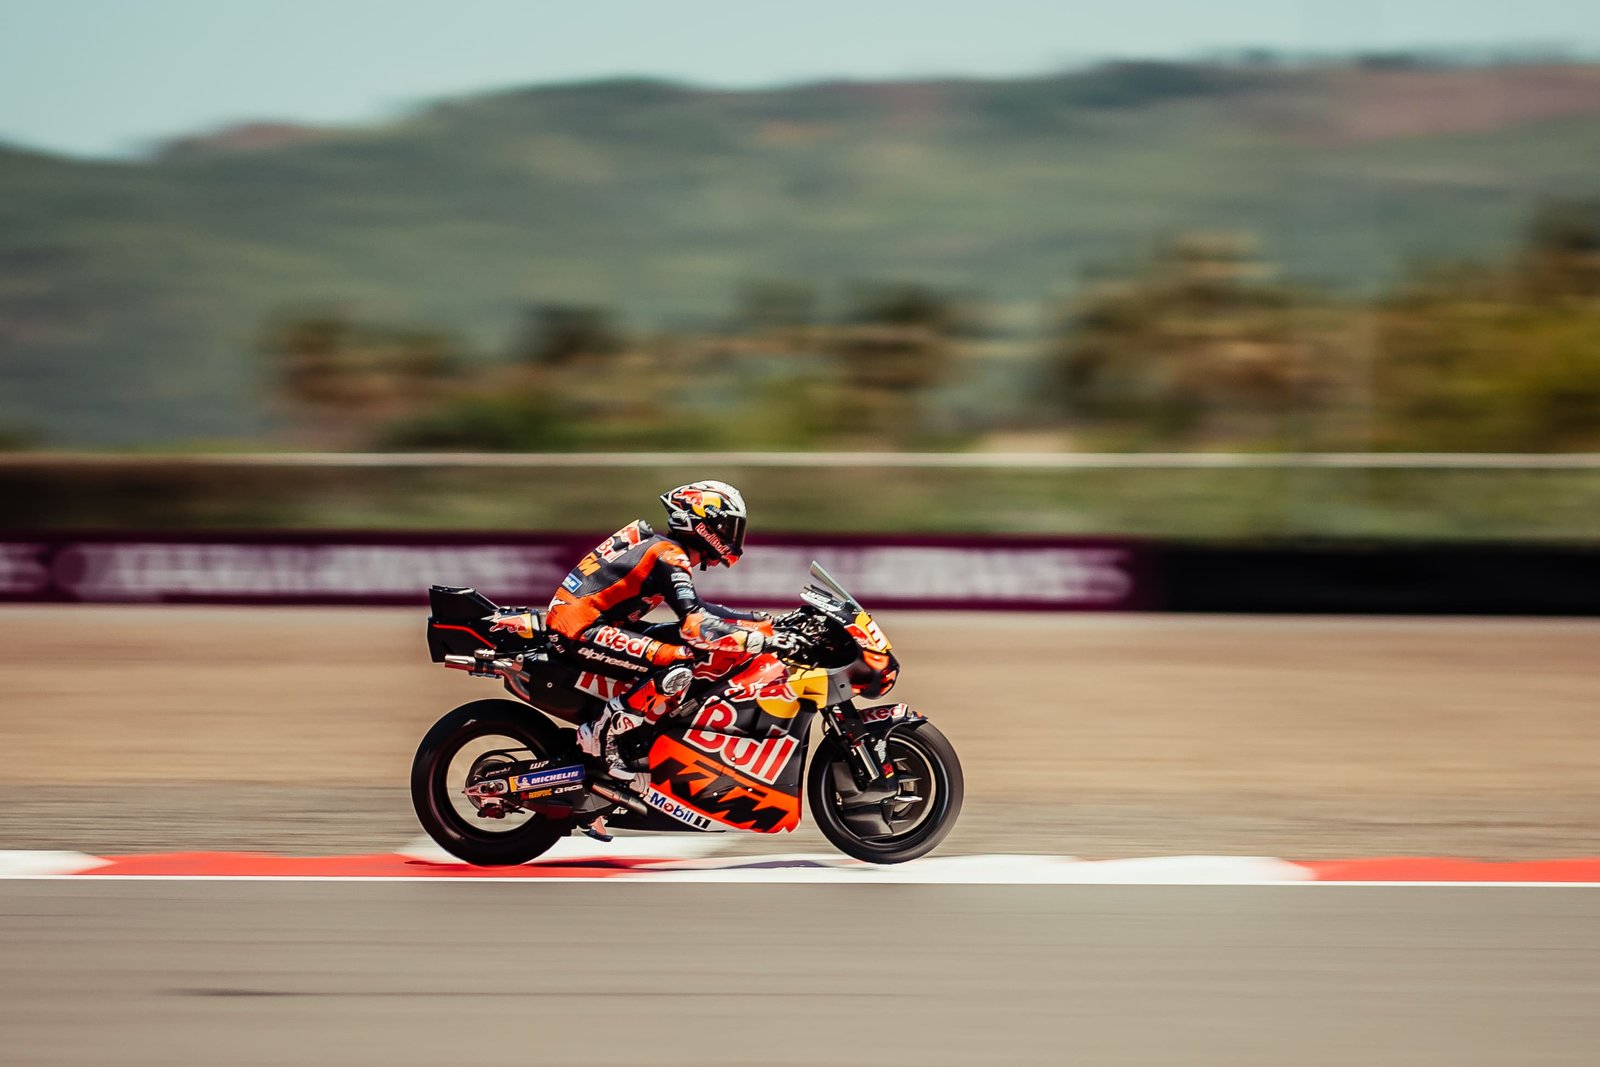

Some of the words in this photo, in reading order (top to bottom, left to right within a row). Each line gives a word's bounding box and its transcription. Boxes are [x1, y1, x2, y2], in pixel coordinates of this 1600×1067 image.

[594, 625, 653, 658] Red
[577, 646, 649, 673] alpinestars
[859, 702, 908, 725] Red
[683, 695, 800, 785] Bull
[529, 760, 550, 770] WP
[531, 770, 579, 785] MICHELIN
[650, 756, 790, 833] KTM
[650, 792, 694, 823] Mobil
